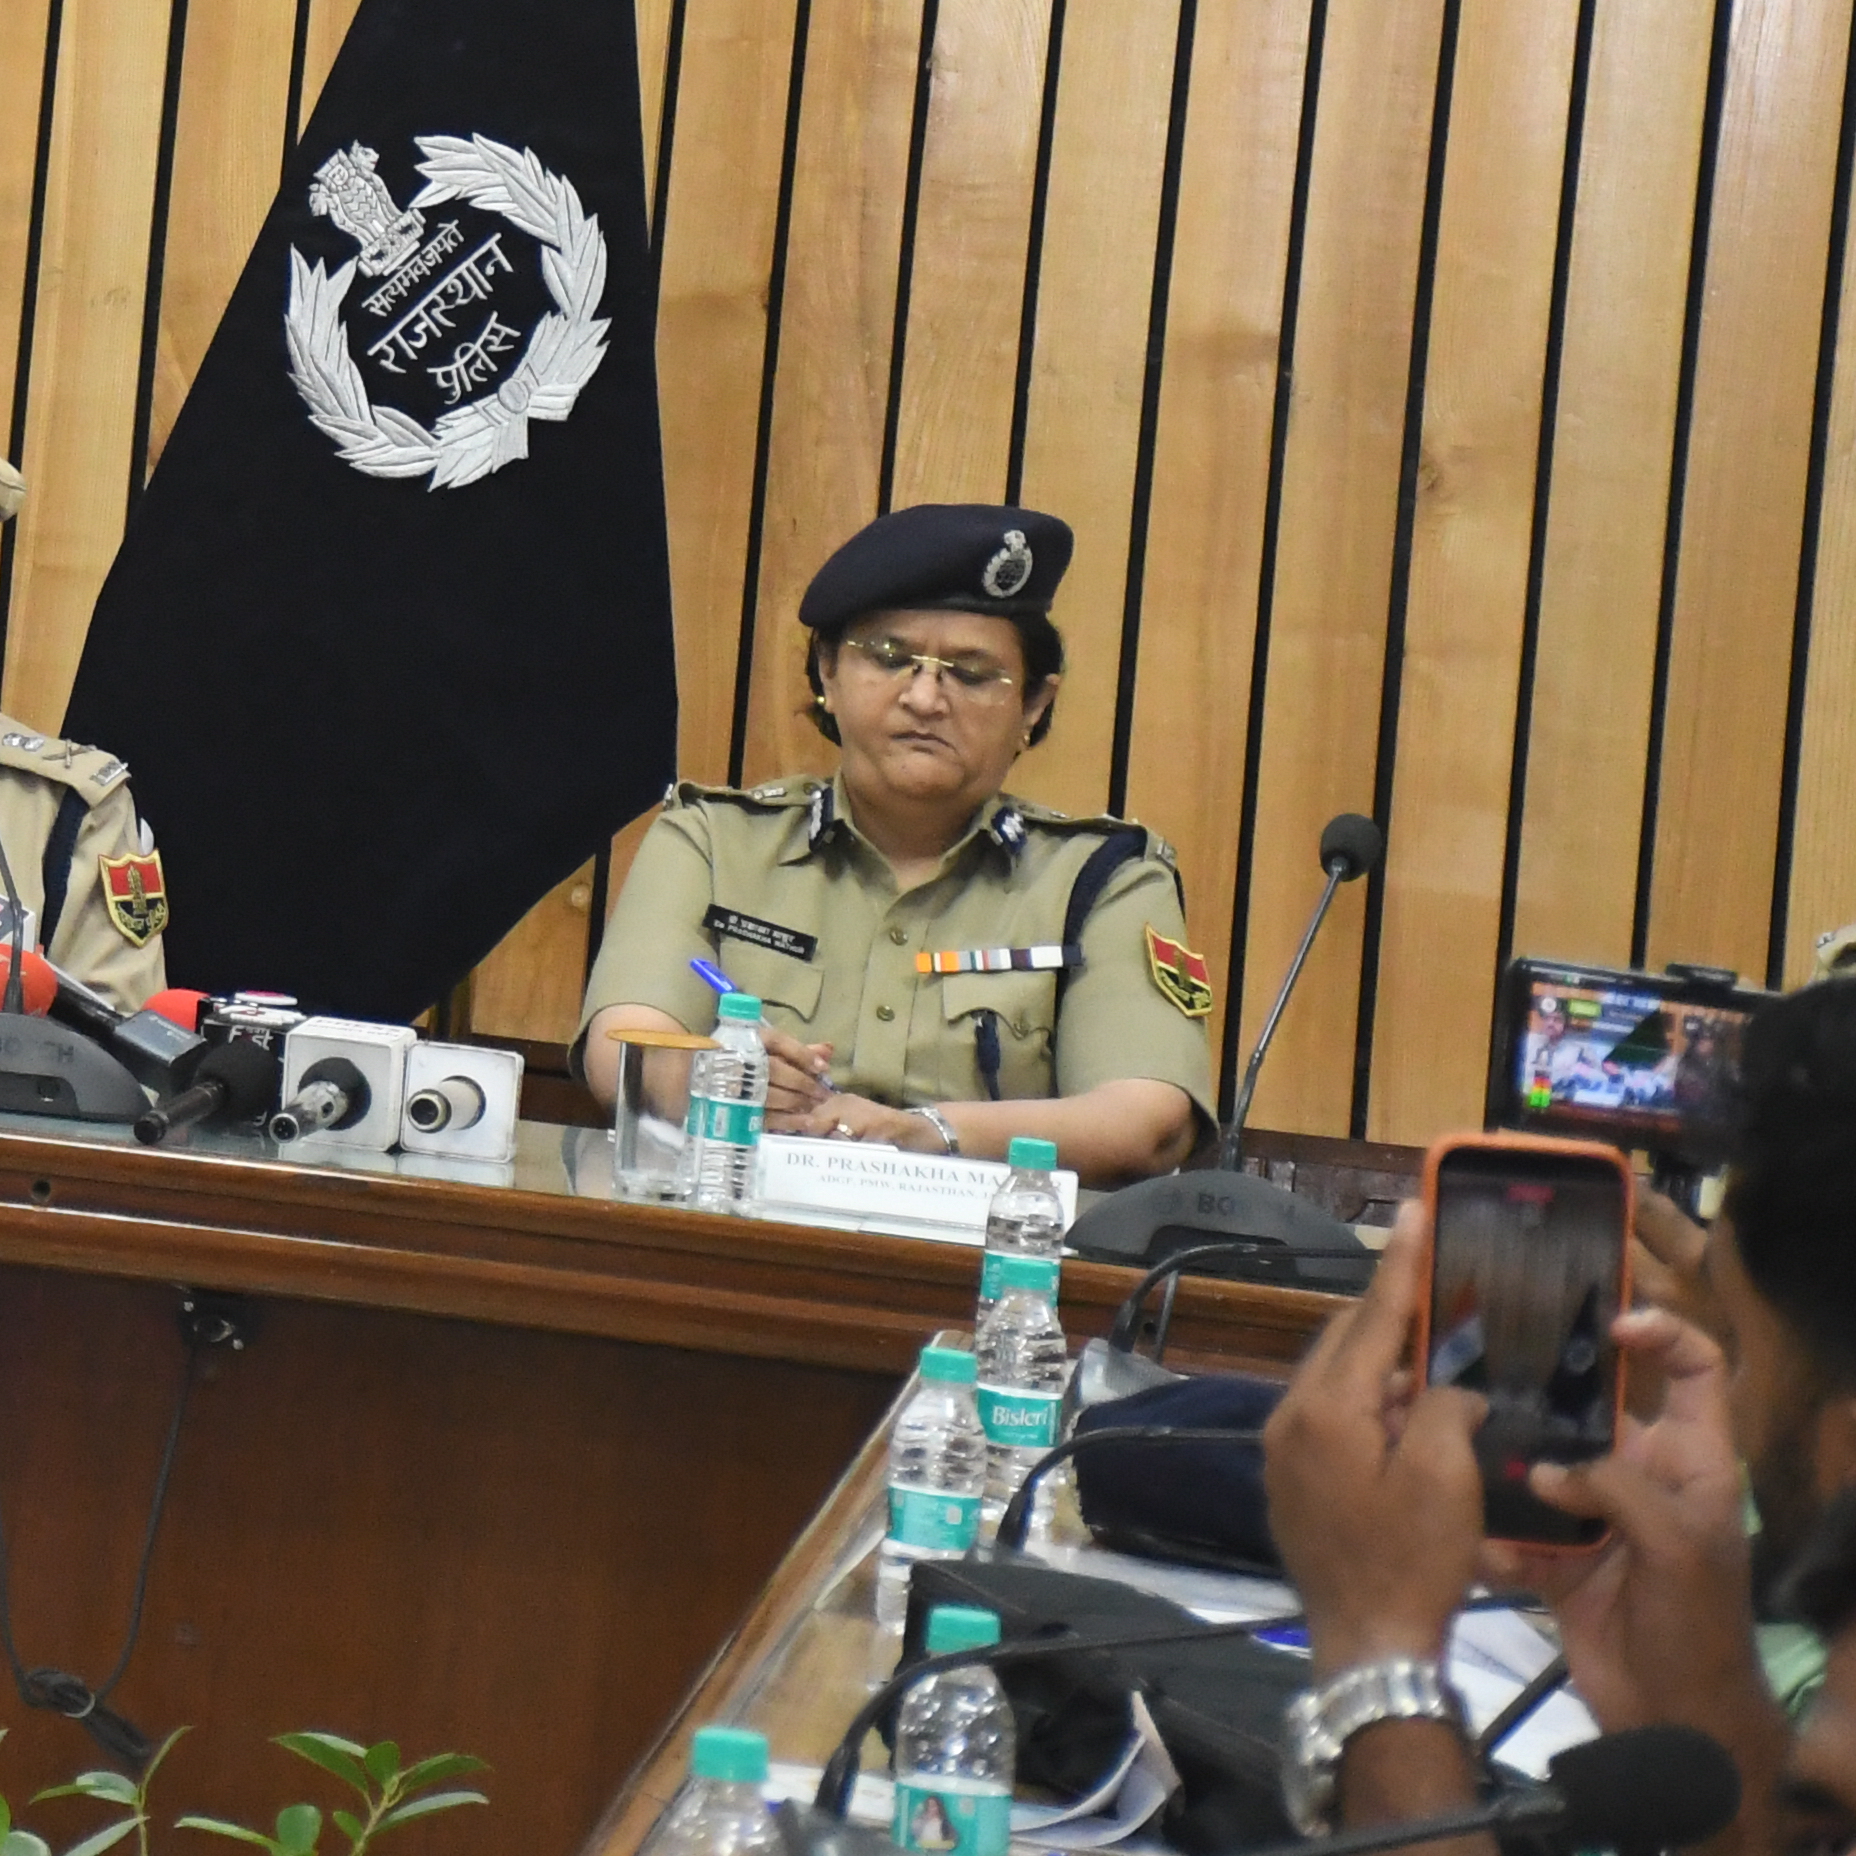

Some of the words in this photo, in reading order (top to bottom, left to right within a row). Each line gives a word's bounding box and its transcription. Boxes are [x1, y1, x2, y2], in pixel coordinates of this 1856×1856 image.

[367, 232, 514, 374] राजस्थान
[426, 310, 522, 405] पुलिस
[786, 1152, 820, 1169] DR.
[827, 1155, 961, 1183] PRASHAKHA
[992, 1404, 1050, 1427] Bisleri
